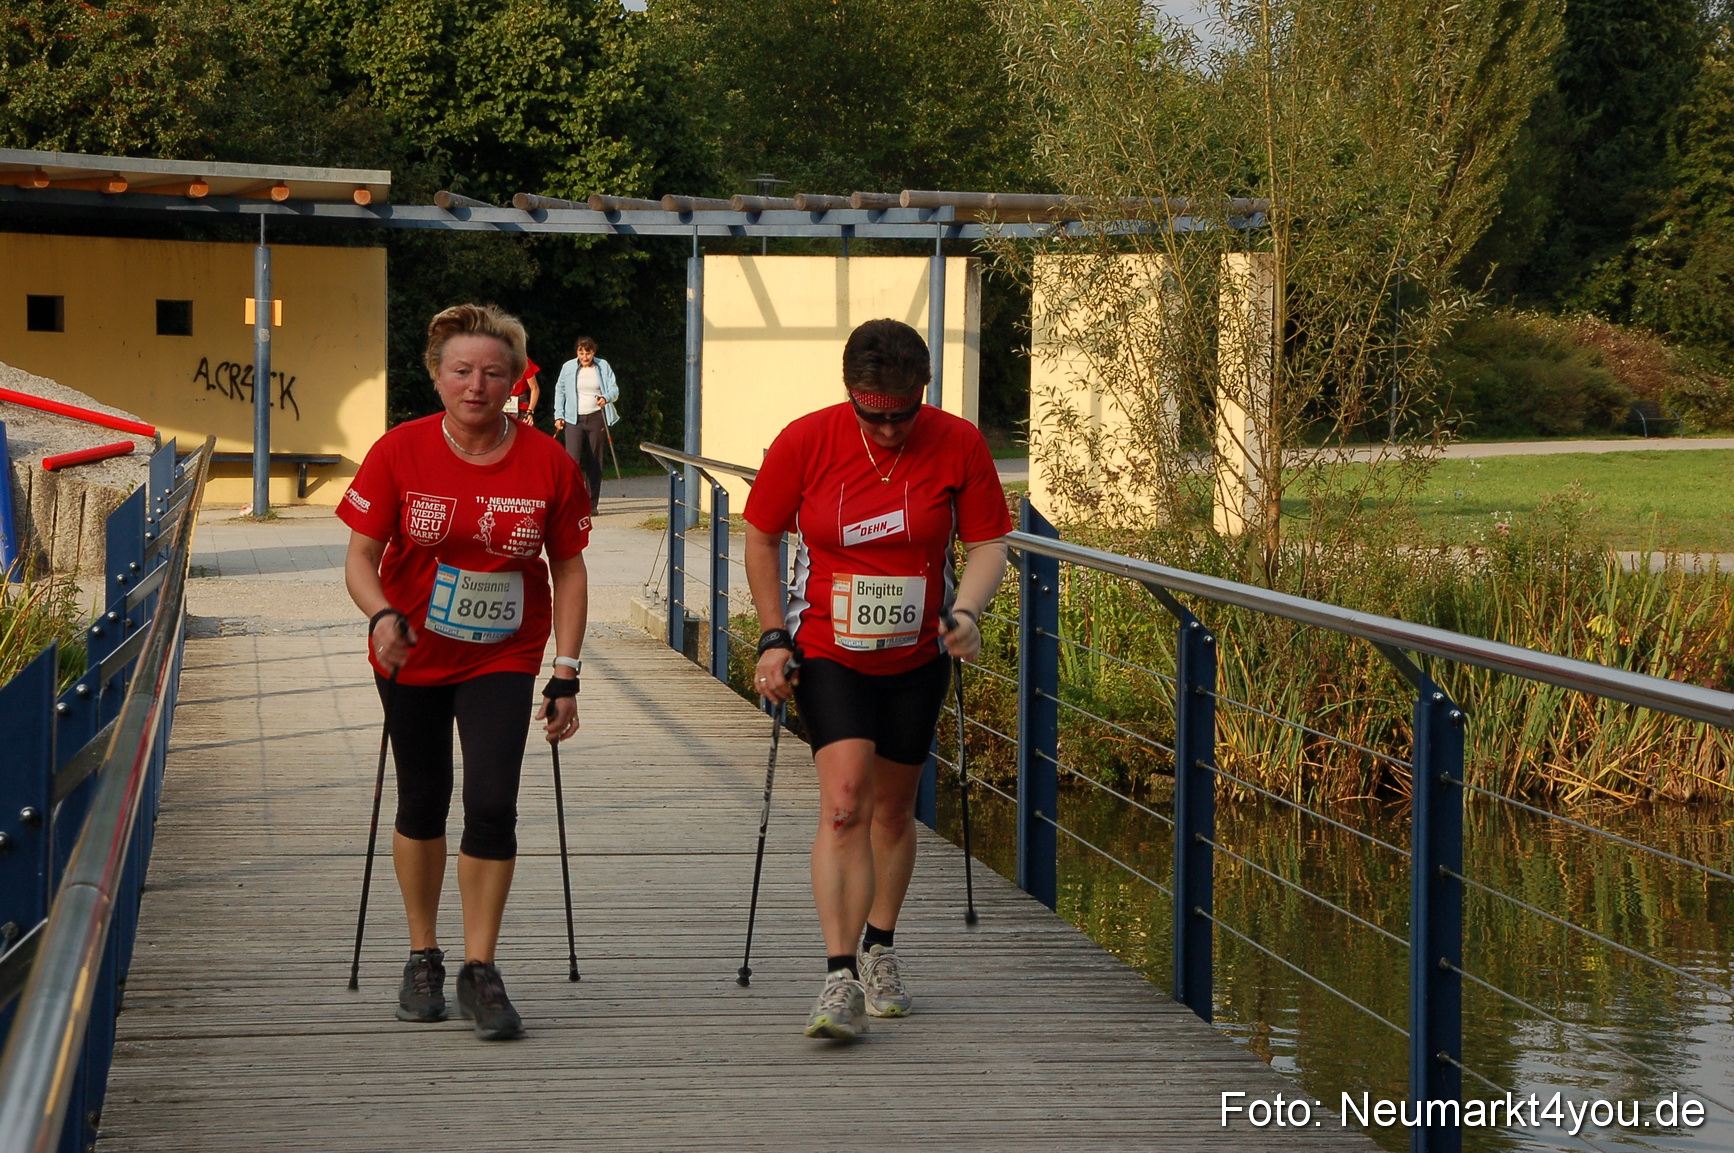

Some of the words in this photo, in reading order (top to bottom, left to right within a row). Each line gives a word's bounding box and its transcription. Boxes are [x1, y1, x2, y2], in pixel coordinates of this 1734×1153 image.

[412, 500, 447, 512] IMMER
[475, 496, 488, 504] 11.
[489, 497, 546, 509] NEUMARKTER
[487, 504, 536, 514] STADTLAUF
[411, 508, 447, 520] WIEDER
[410, 517, 443, 532] NEU
[860, 521, 888, 537] DEHN
[410, 528, 440, 540] MARKT
[461, 576, 510, 593] Susanne
[857, 581, 903, 599] Brigitte
[457, 598, 516, 621] 8055
[857, 605, 917, 625] 8056
